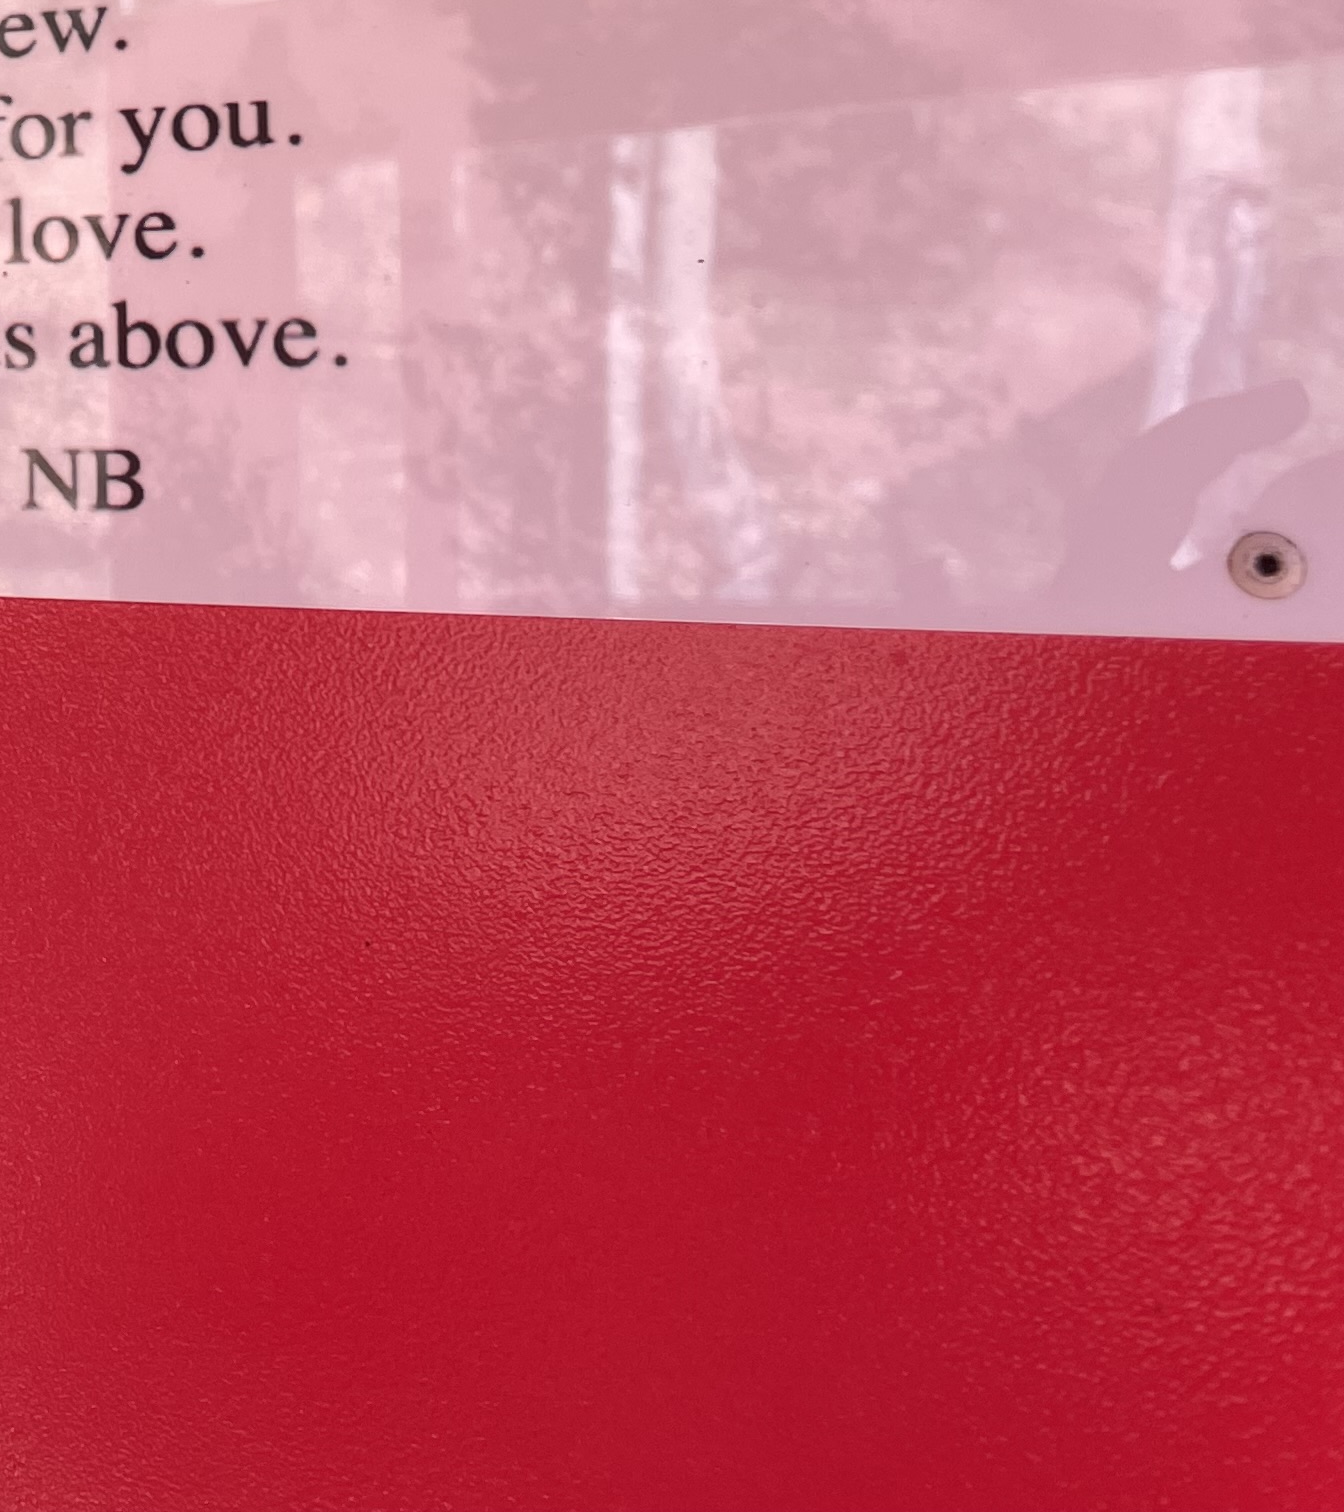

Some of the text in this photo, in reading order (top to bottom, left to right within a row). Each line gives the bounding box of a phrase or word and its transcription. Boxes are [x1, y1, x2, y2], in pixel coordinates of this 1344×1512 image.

[118, 98, 305, 176] you.
[4, 196, 206, 265] love.
[68, 299, 348, 371] above.
[20, 446, 146, 515] NB
